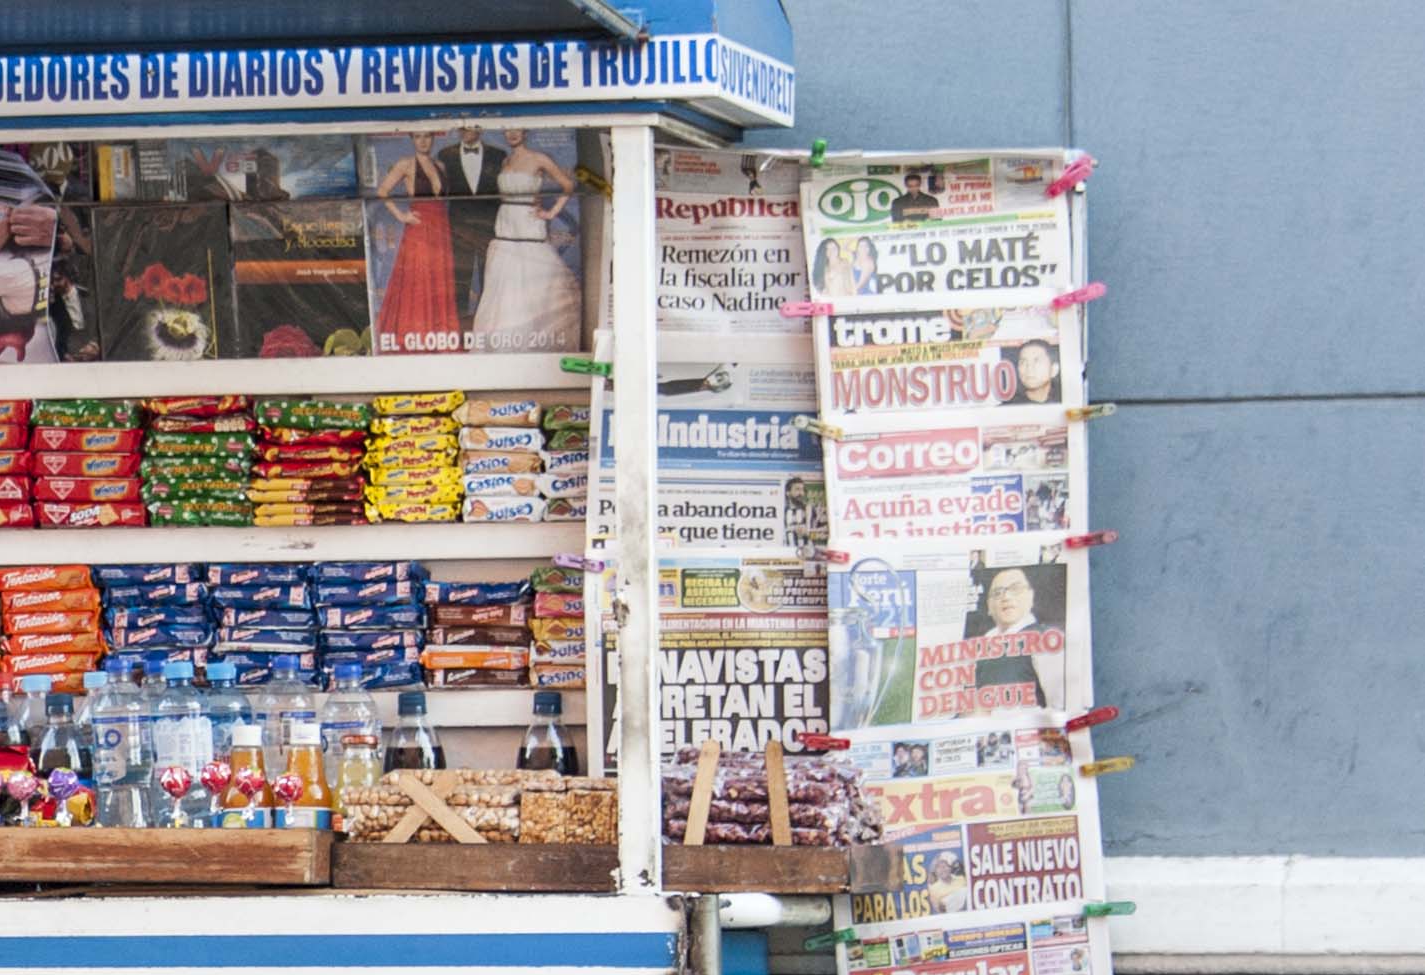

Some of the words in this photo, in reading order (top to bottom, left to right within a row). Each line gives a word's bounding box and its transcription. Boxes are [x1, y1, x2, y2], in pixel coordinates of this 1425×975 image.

[140, 51, 181, 100] DE
[188, 49, 324, 98] DIARIOS
[335, 47, 359, 94] Y
[361, 44, 519, 94] REVISTAS
[529, 41, 570, 90] DE
[576, 38, 719, 88] TRUJILLO
[656, 196, 800, 225] República
[661, 244, 758, 266] Remezón
[764, 248, 790, 263] en
[957, 232, 1041, 265] MATÉ
[660, 267, 677, 287] la
[684, 267, 755, 289] fiscalía
[763, 271, 801, 293] por
[876, 270, 936, 295] POR
[657, 293, 706, 311] caso
[712, 292, 787, 313] Nadine
[379, 333, 399, 351] EL
[404, 332, 460, 351] GLOBO
[464, 331, 485, 349] DE
[490, 331, 522, 349] ORO
[528, 329, 566, 347] 2014
[834, 314, 952, 347] trome
[831, 360, 1017, 410] MONSTRUO
[657, 413, 800, 450] Industria
[838, 438, 979, 472] Correo
[466, 475, 514, 493] Casino
[672, 500, 778, 518] abandona
[843, 494, 935, 521] Acuña
[938, 488, 1022, 516] evade
[679, 526, 719, 546] que
[722, 524, 775, 541] tiene
[1, 568, 57, 590] Tentación
[918, 627, 1065, 669] MINISTRO
[919, 664, 976, 692] CON
[662, 684, 776, 718] RETAN
[783, 684, 822, 717] EL
[918, 682, 1037, 719] DENGUE
[971, 841, 1014, 877] SALE
[1018, 837, 1080, 873] NUEVO
[853, 892, 895, 924] PARA
[900, 889, 932, 917] LOS
[974, 874, 1082, 910] CONTRATO
